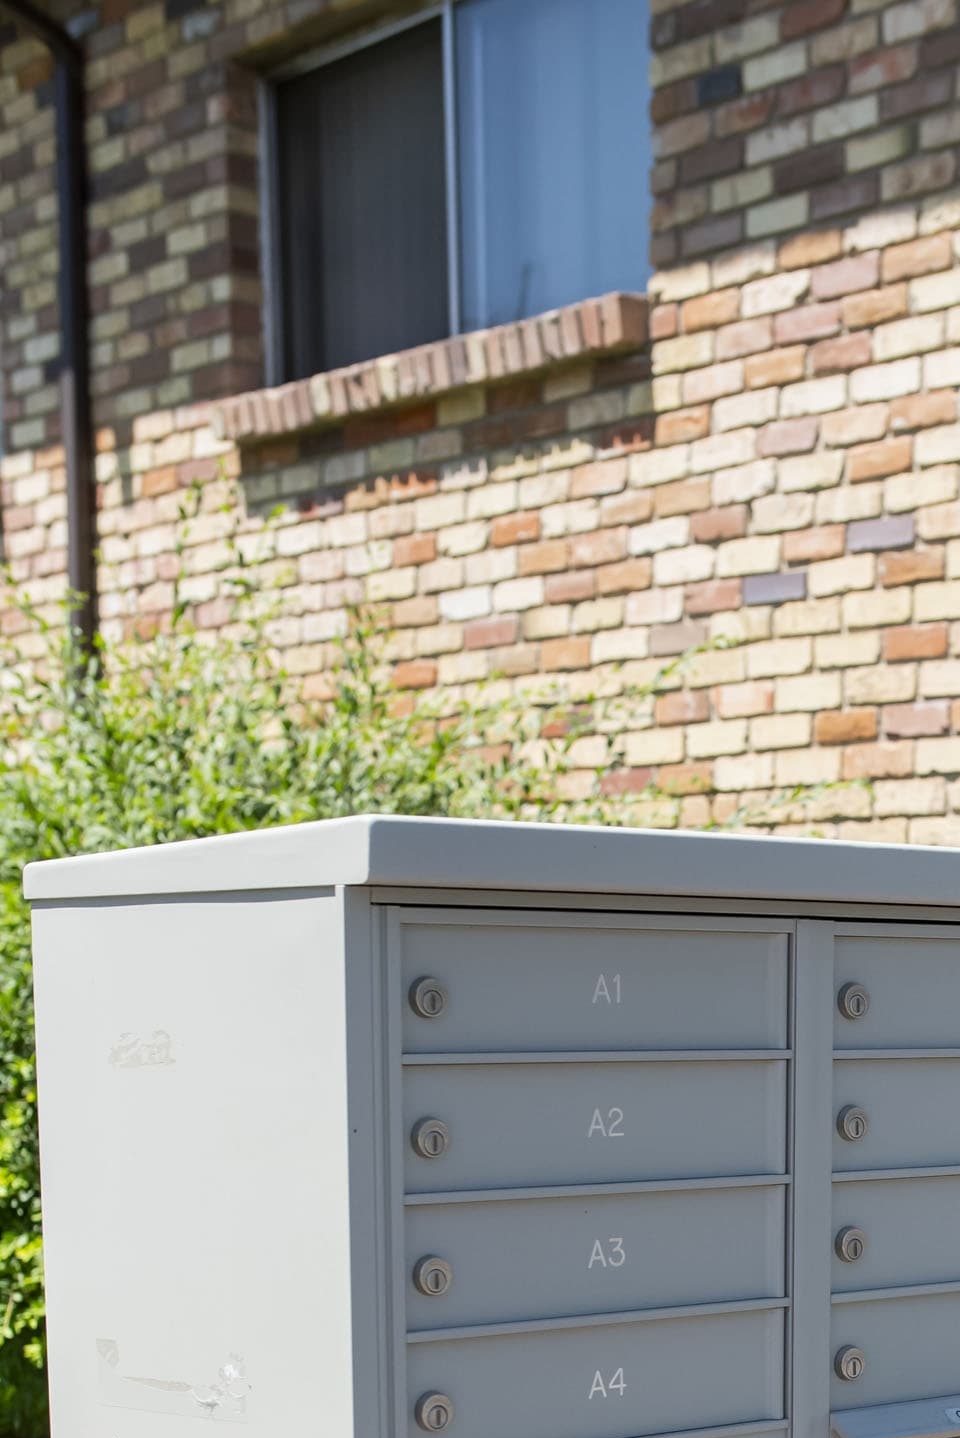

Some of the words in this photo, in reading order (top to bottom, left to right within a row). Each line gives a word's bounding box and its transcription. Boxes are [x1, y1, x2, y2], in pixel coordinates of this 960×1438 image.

[592, 974, 620, 1003] A1
[588, 1108, 624, 1137] A2
[588, 1238, 625, 1268] A3
[589, 1368, 627, 1399] A4
